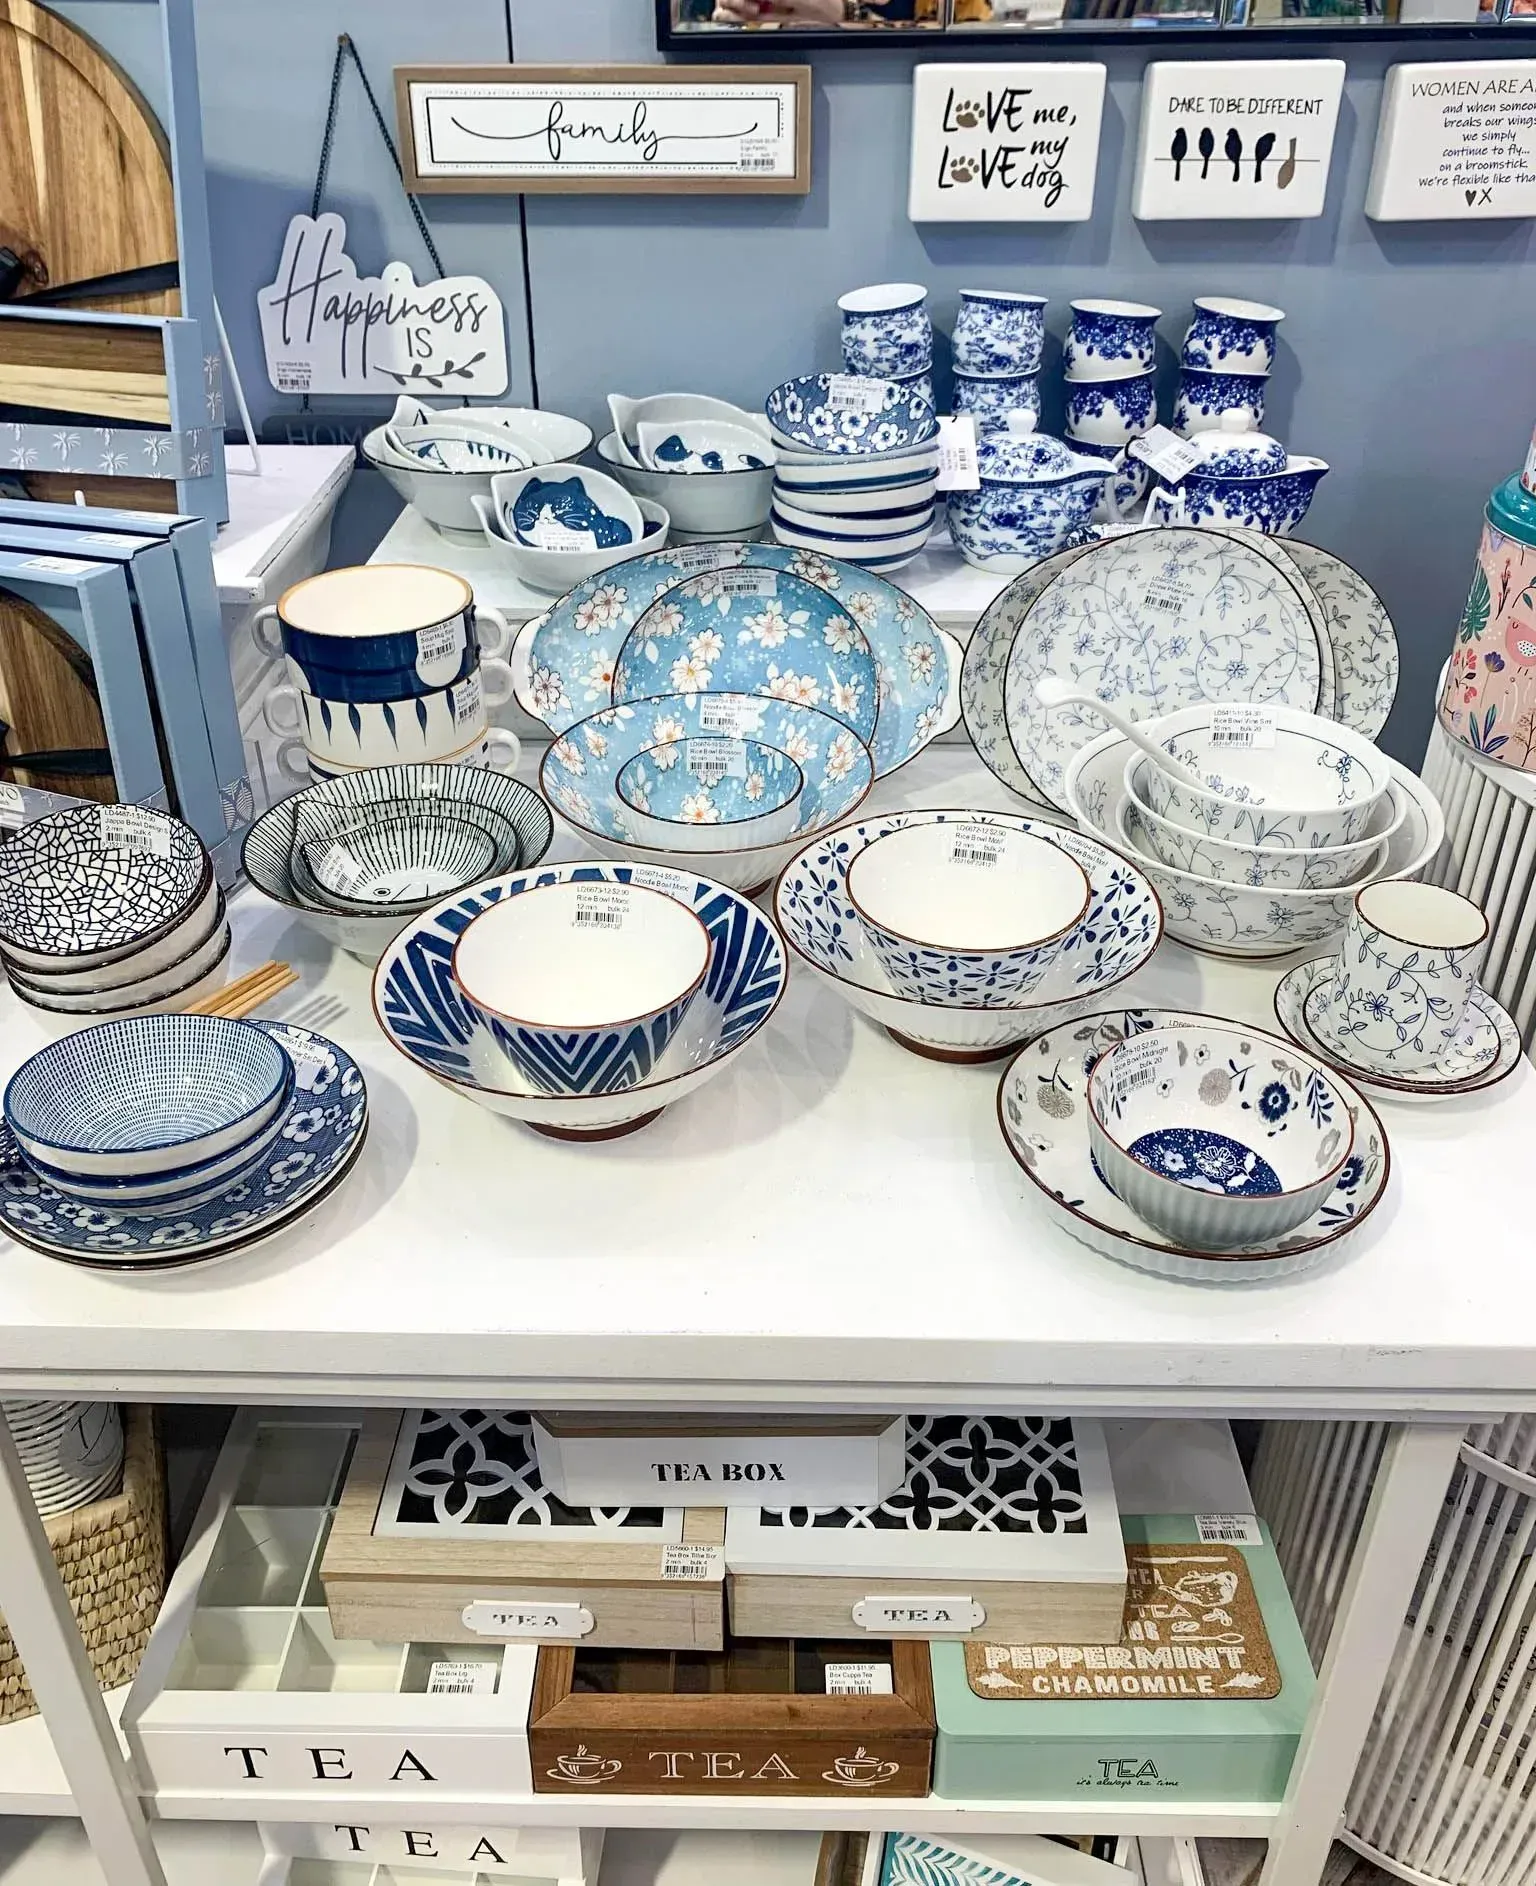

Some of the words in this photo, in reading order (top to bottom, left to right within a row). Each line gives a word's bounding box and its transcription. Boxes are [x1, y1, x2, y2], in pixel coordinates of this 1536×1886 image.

[1411, 81, 1480, 97] WOMEN
[1483, 79, 1518, 95] ARE
[1168, 97, 1205, 113] DARE
[1209, 97, 1225, 113] TO
[1226, 98, 1245, 113] BE
[1247, 98, 1324, 115] DIFFERENT
[1442, 102, 1463, 114] and
[1467, 102, 1496, 113] when
[1033, 105, 1077, 126] me,
[1444, 117, 1482, 128] breaks
[1485, 118, 1504, 127] our
[1463, 133, 1478, 142] we
[1481, 130, 1516, 142] simply
[1030, 136, 1069, 169] my
[1442, 146, 1488, 157] continue
[1492, 146, 1504, 155] to
[1439, 162, 1451, 172] on
[1455, 162, 1462, 170] a
[1021, 163, 1069, 208] dog
[1452, 174, 1490, 186] flexible
[1492, 173, 1512, 184] like
[269, 228, 488, 379] Happiness
[405, 327, 433, 358] IS
[955, 832, 970, 840] Rice
[971, 834, 988, 842] Bowl
[1065, 843, 1082, 855] Noodle
[1081, 851, 1097, 861] Bowl
[634, 876, 655, 885] Noodle
[656, 880, 671, 888] Bowl
[664, 873, 681, 881] $5.20
[593, 895, 610, 903] Bowl
[611, 888, 630, 896] $2.90
[1141, 1040, 1159, 1050] $2.50
[1115, 1062, 1127, 1072] Rice
[1126, 1053, 1141, 1066] Bowl
[1141, 1046, 1169, 1059] Midnight
[1139, 1060, 1152, 1069] bulk
[1154, 1056, 1163, 1064] 20
[651, 1463, 712, 1482] TEA
[722, 1463, 786, 1481] BOX
[884, 1609, 953, 1621] TEA
[1130, 1604, 1193, 1618] TEA
[493, 1614, 559, 1626] TEA
[985, 1646, 1246, 1669] PEPPERMINT
[1032, 1674, 1216, 1694] CHAMOMILE
[224, 1747, 439, 1782] TEA
[648, 1752, 800, 1780] TEA
[1098, 1759, 1159, 1778] TEA
[1096, 1777, 1132, 1788] always
[1156, 1777, 1180, 1786] time
[334, 1825, 509, 1864] TEA
